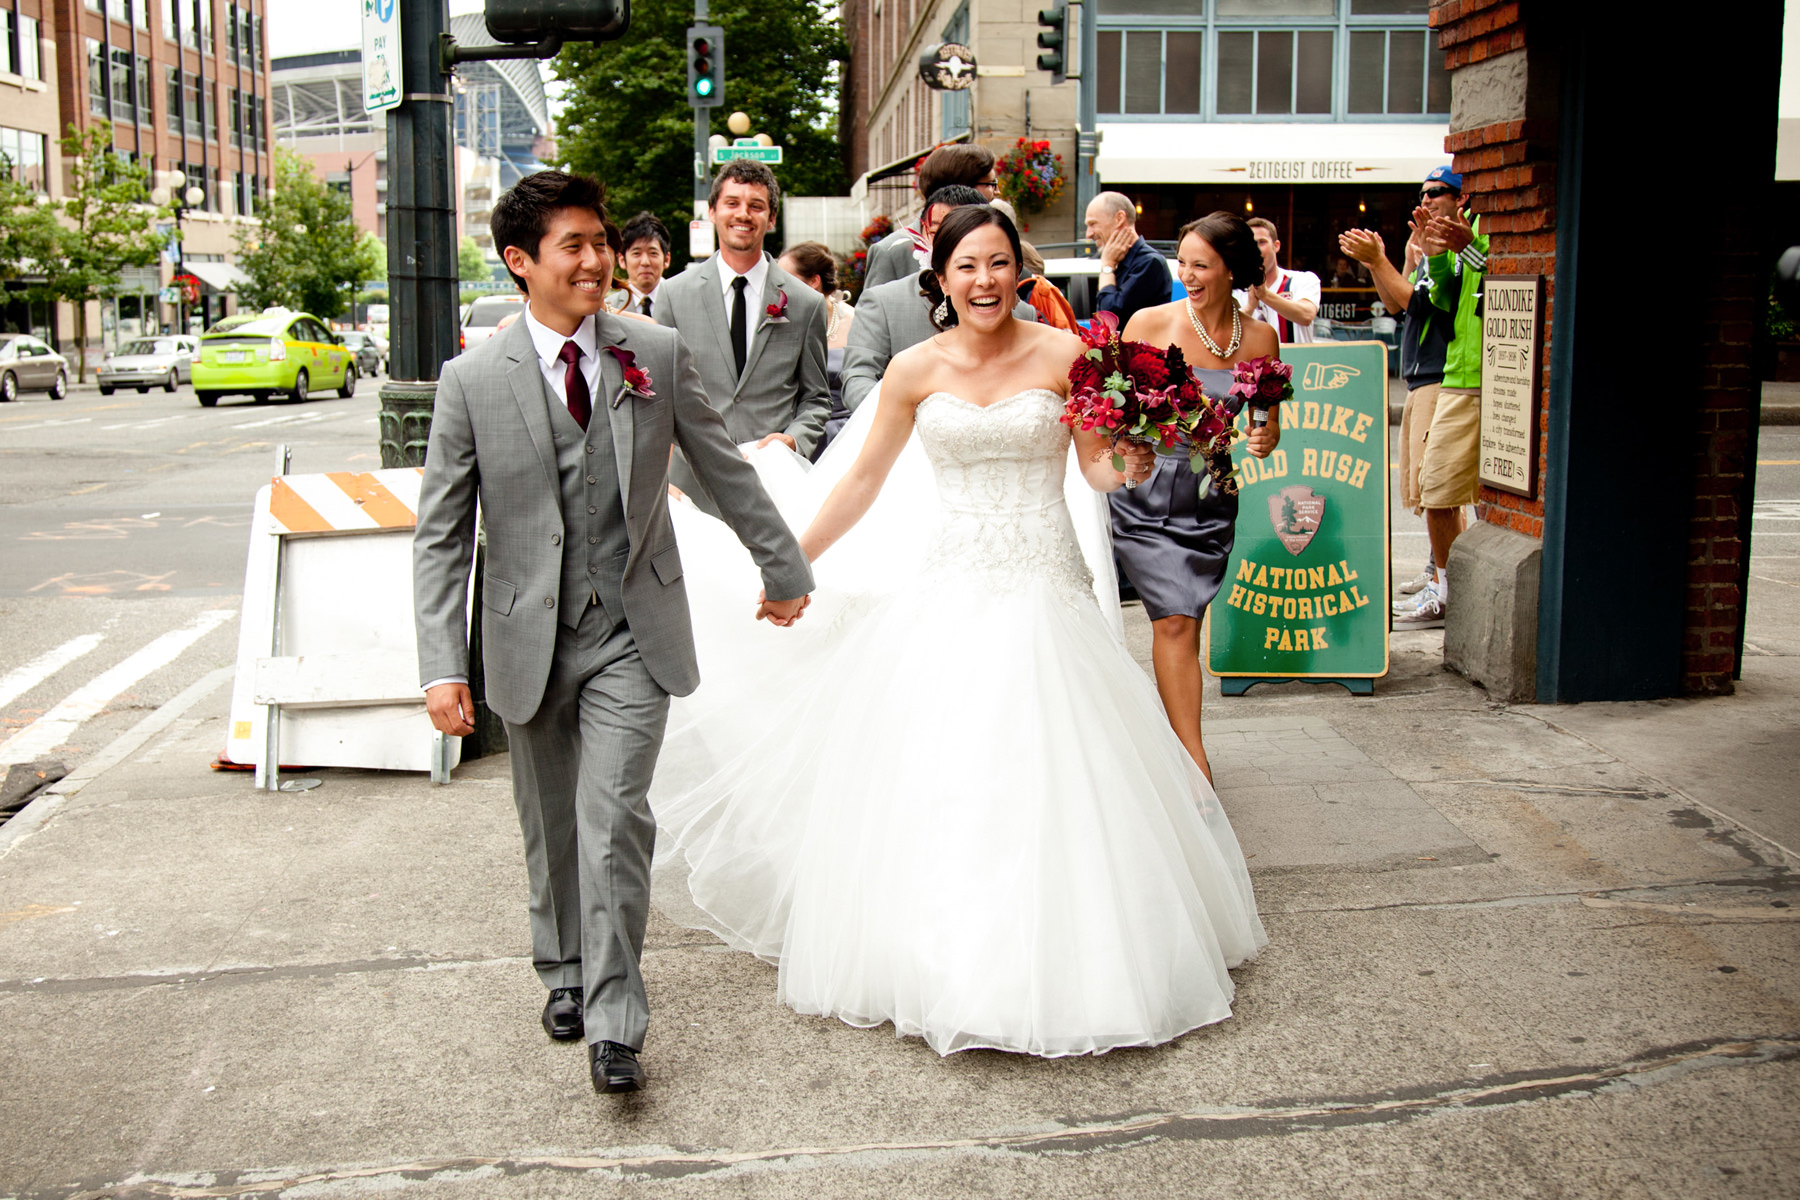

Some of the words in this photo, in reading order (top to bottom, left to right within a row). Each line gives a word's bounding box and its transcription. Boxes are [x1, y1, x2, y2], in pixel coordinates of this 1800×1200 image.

[374, 35, 386, 51] PAY
[730, 150, 765, 159] Jackson
[1249, 161, 1305, 179] ZEITGEIST
[1312, 161, 1352, 179] COFFEE
[1319, 303, 1356, 319] ITGEIST
[1488, 289, 1533, 312] KLONDIKE
[1487, 317, 1507, 338] GOLD
[1510, 318, 1532, 340] RUSH
[1231, 401, 1374, 443] KNDIKE
[1302, 448, 1372, 489] RUSH
[1494, 457, 1515, 480] FREE!
[1236, 559, 1358, 590] NATIONAL
[1227, 583, 1370, 619] HISTORICAL
[1264, 627, 1329, 651] PARK
